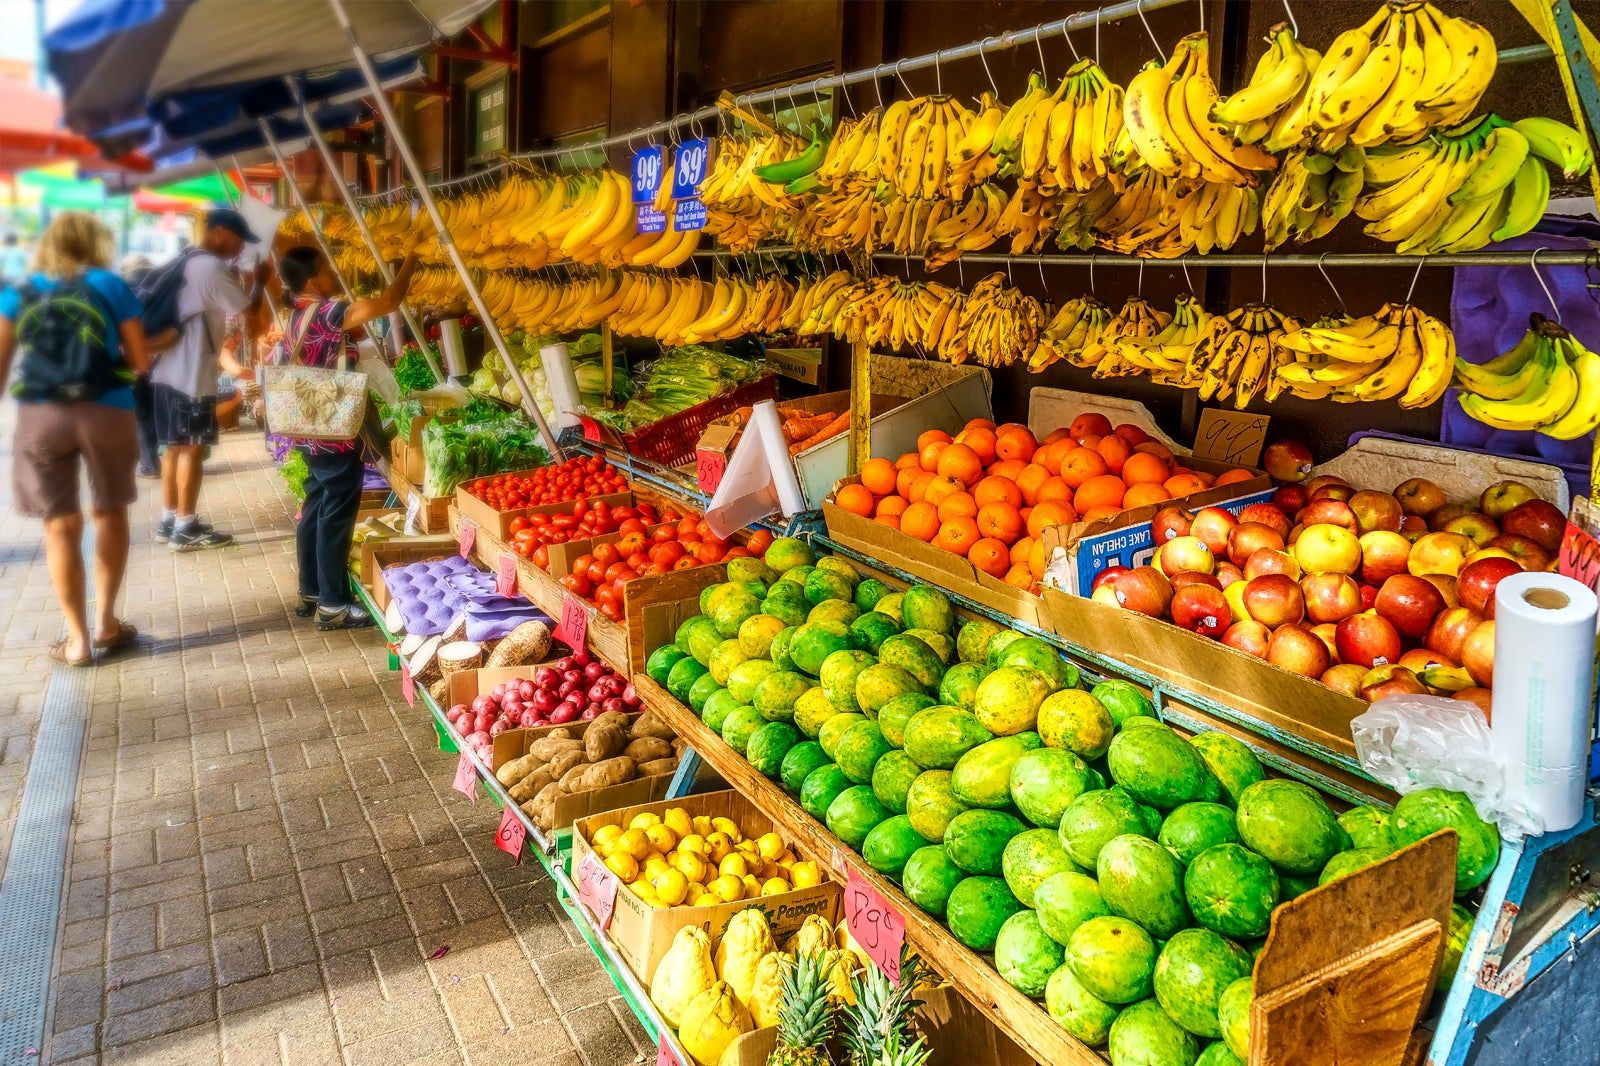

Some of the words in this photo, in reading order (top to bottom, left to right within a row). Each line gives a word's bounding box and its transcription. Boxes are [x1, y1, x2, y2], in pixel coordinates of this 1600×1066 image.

[636, 154, 661, 191] 99¢
[679, 145, 707, 187] 89¢
[1091, 536, 1127, 556] CHELAN
[1128, 529, 1151, 547] LAKE
[631, 901, 641, 916] NO.
[777, 899, 829, 920] Papaya
